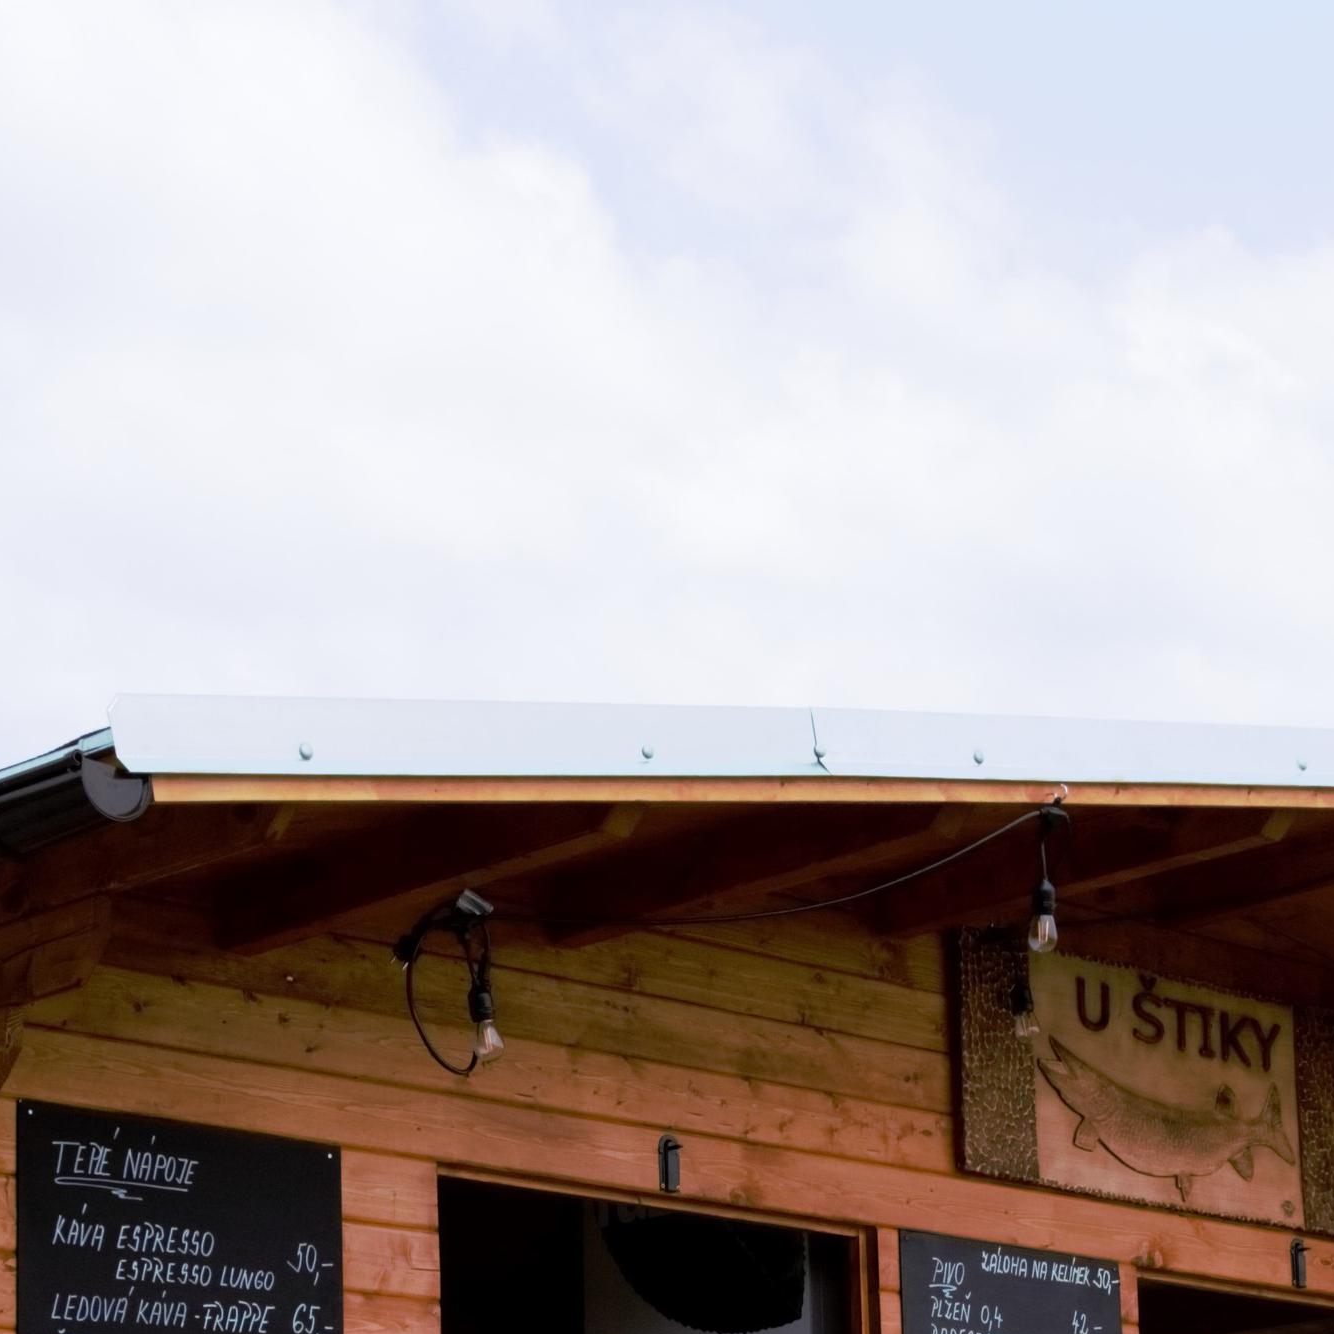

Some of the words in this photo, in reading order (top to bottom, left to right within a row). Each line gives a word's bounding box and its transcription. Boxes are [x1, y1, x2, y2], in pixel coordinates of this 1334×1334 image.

[1076, 976, 1110, 1032] U
[1131, 975, 1281, 1072] ŠTIKY
[52, 1127, 119, 1176] TEPLÉ
[122, 1135, 198, 1185] NÁPOJE
[52, 1203, 105, 1252] KÁVA
[117, 1222, 215, 1256] ESPRESSO
[116, 1257, 211, 1287] ESPRESSO
[220, 1266, 274, 1291] LUNGO
[932, 1257, 965, 1285] PIVO
[982, 1247, 1027, 1278] ZÁLOHA
[1032, 1260, 1047, 1280] NA
[1051, 1257, 1091, 1287] KELÍMEK
[51, 1287, 134, 1323] LEDOVÁ
[137, 1290, 187, 1328] KÁVA
[931, 1292, 971, 1323] PLZEŇ
[981, 1305, 1003, 1331] 0,4
